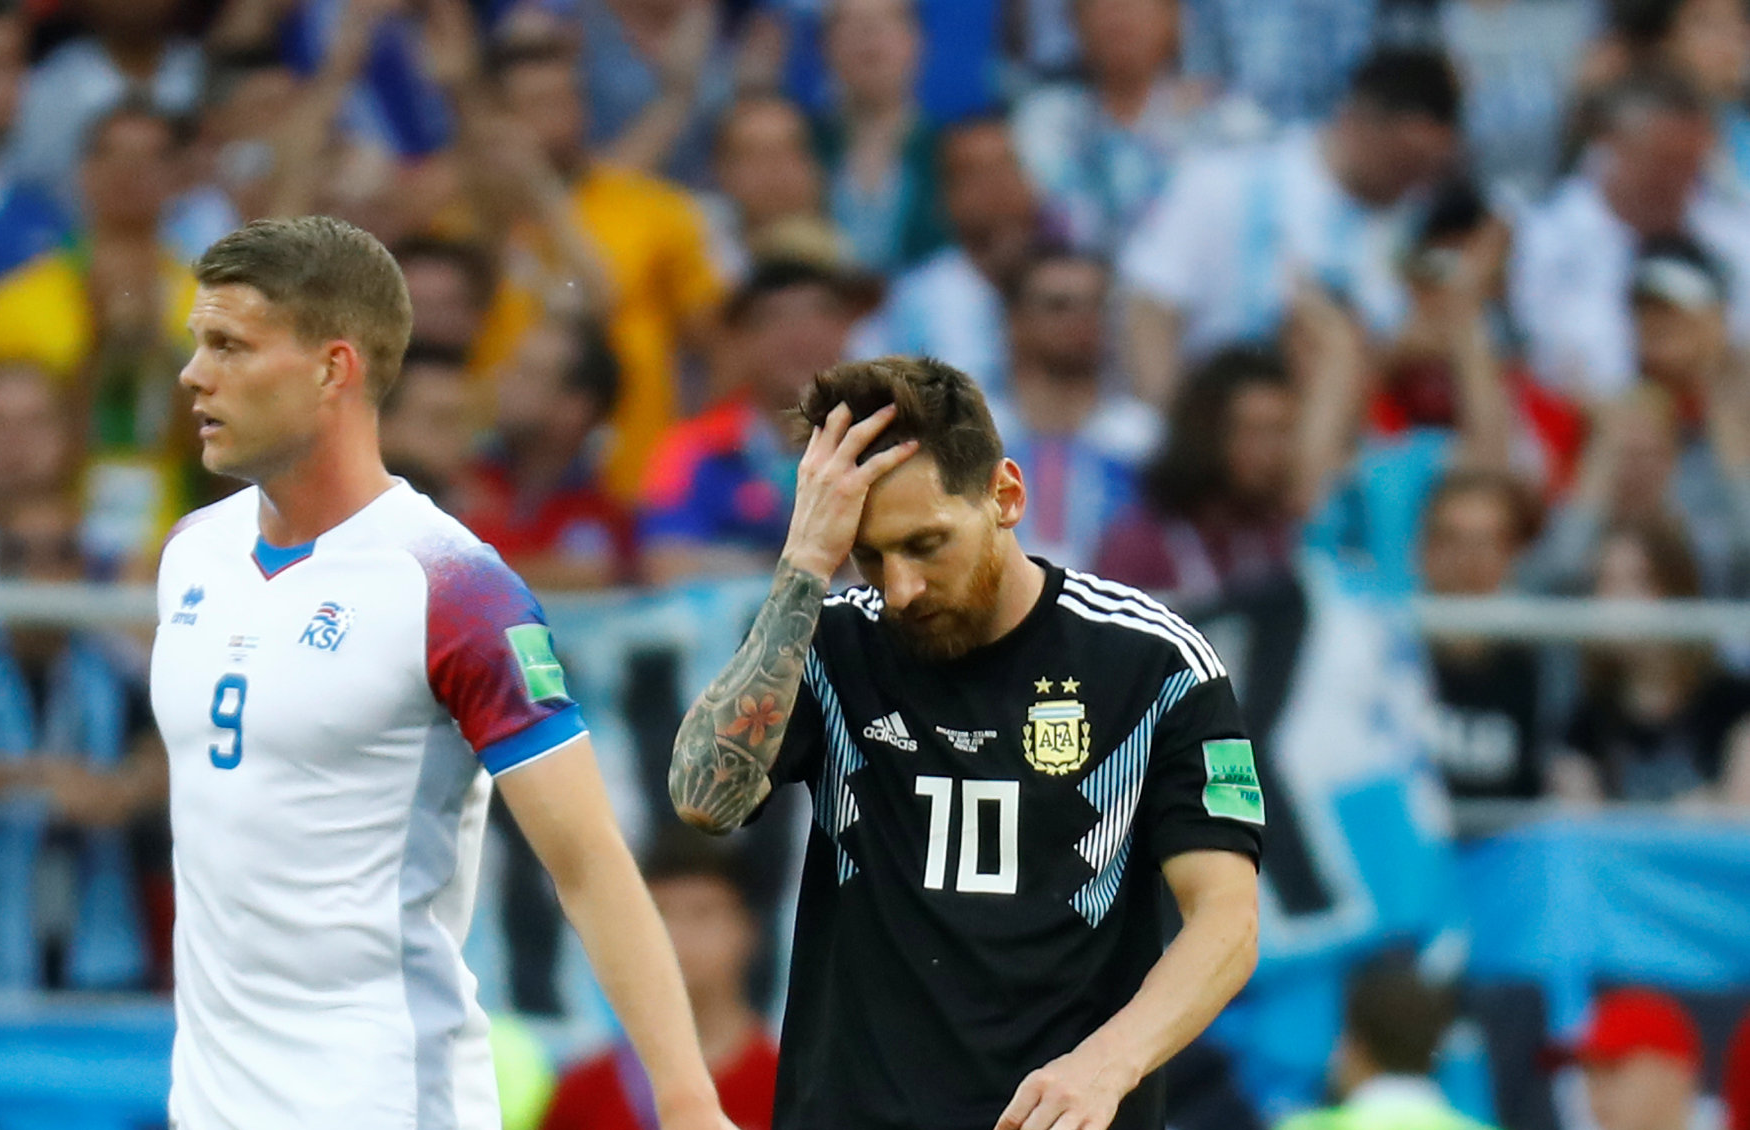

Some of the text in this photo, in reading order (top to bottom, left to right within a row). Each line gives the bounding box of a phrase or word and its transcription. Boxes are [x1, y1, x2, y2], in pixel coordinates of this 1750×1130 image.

[209, 672, 248, 770] 9
[863, 726, 918, 751] adidas
[1038, 720, 1075, 753] AFA
[915, 775, 1020, 895] 10
